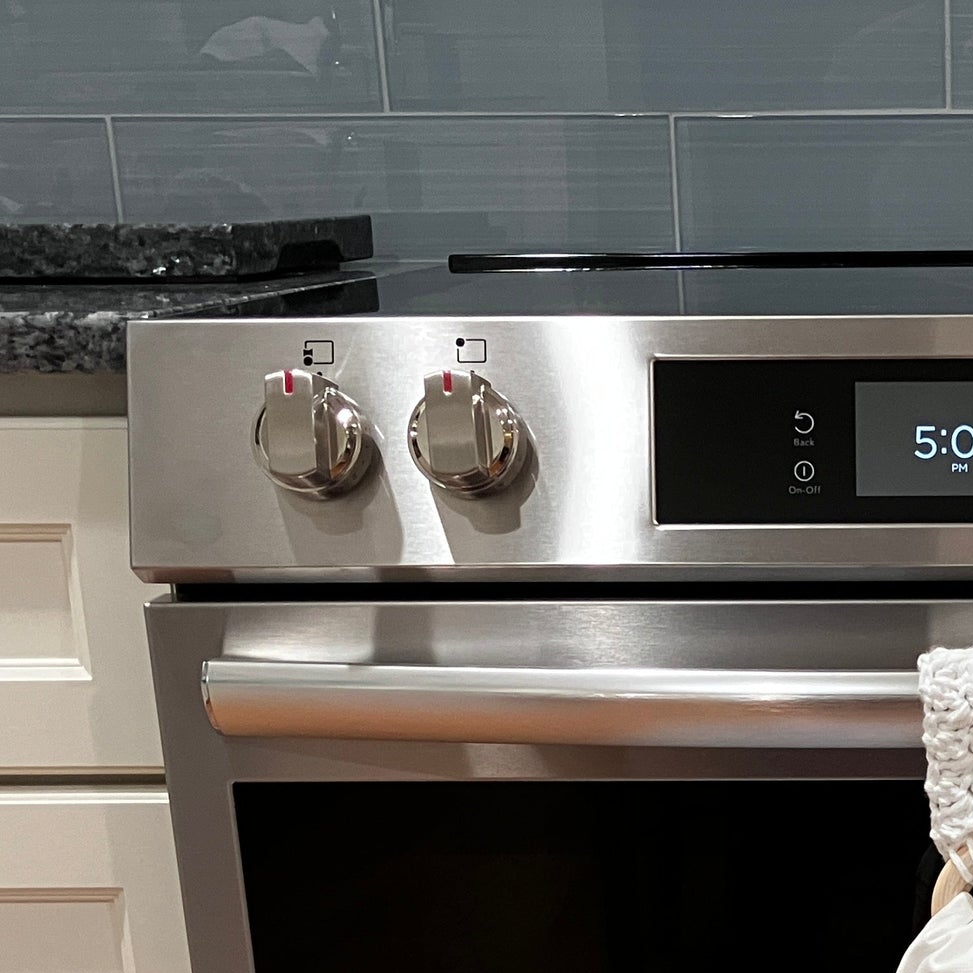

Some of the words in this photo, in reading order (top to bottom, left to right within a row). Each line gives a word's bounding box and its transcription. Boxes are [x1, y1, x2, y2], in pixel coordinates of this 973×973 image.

[793, 438, 815, 447] Back
[952, 463, 968, 473] PM
[788, 485, 821, 495] On-Off
